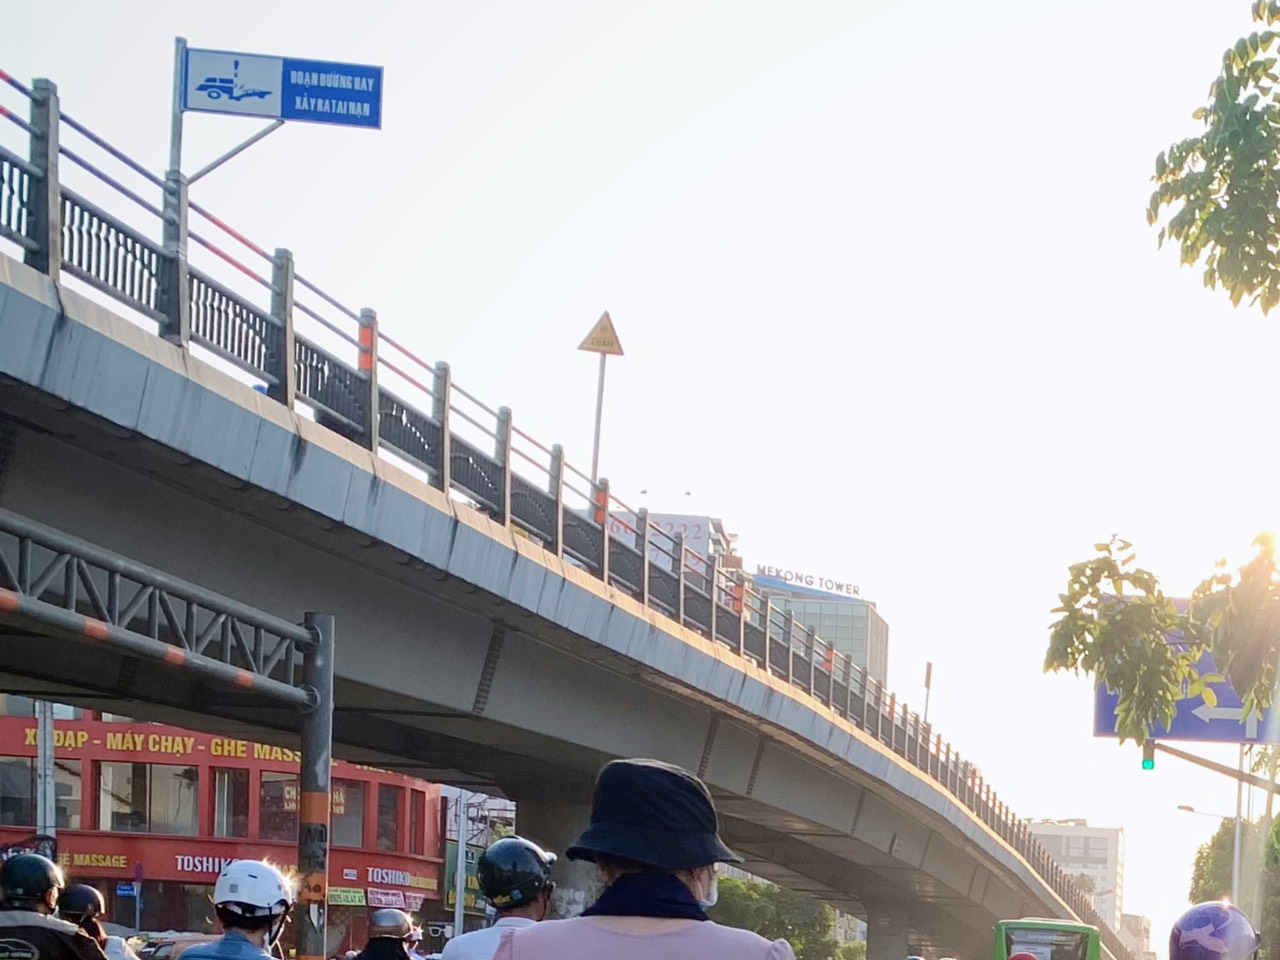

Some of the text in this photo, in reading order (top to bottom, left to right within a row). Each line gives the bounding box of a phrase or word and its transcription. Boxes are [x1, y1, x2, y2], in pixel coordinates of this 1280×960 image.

[757, 563, 861, 596] MEKONG TOWER
[107, 729, 144, 751] MÁY
[149, 734, 195, 757] CHẠY
[73, 854, 128, 868] MASSAGE
[366, 866, 411, 886] TOSHIKO
